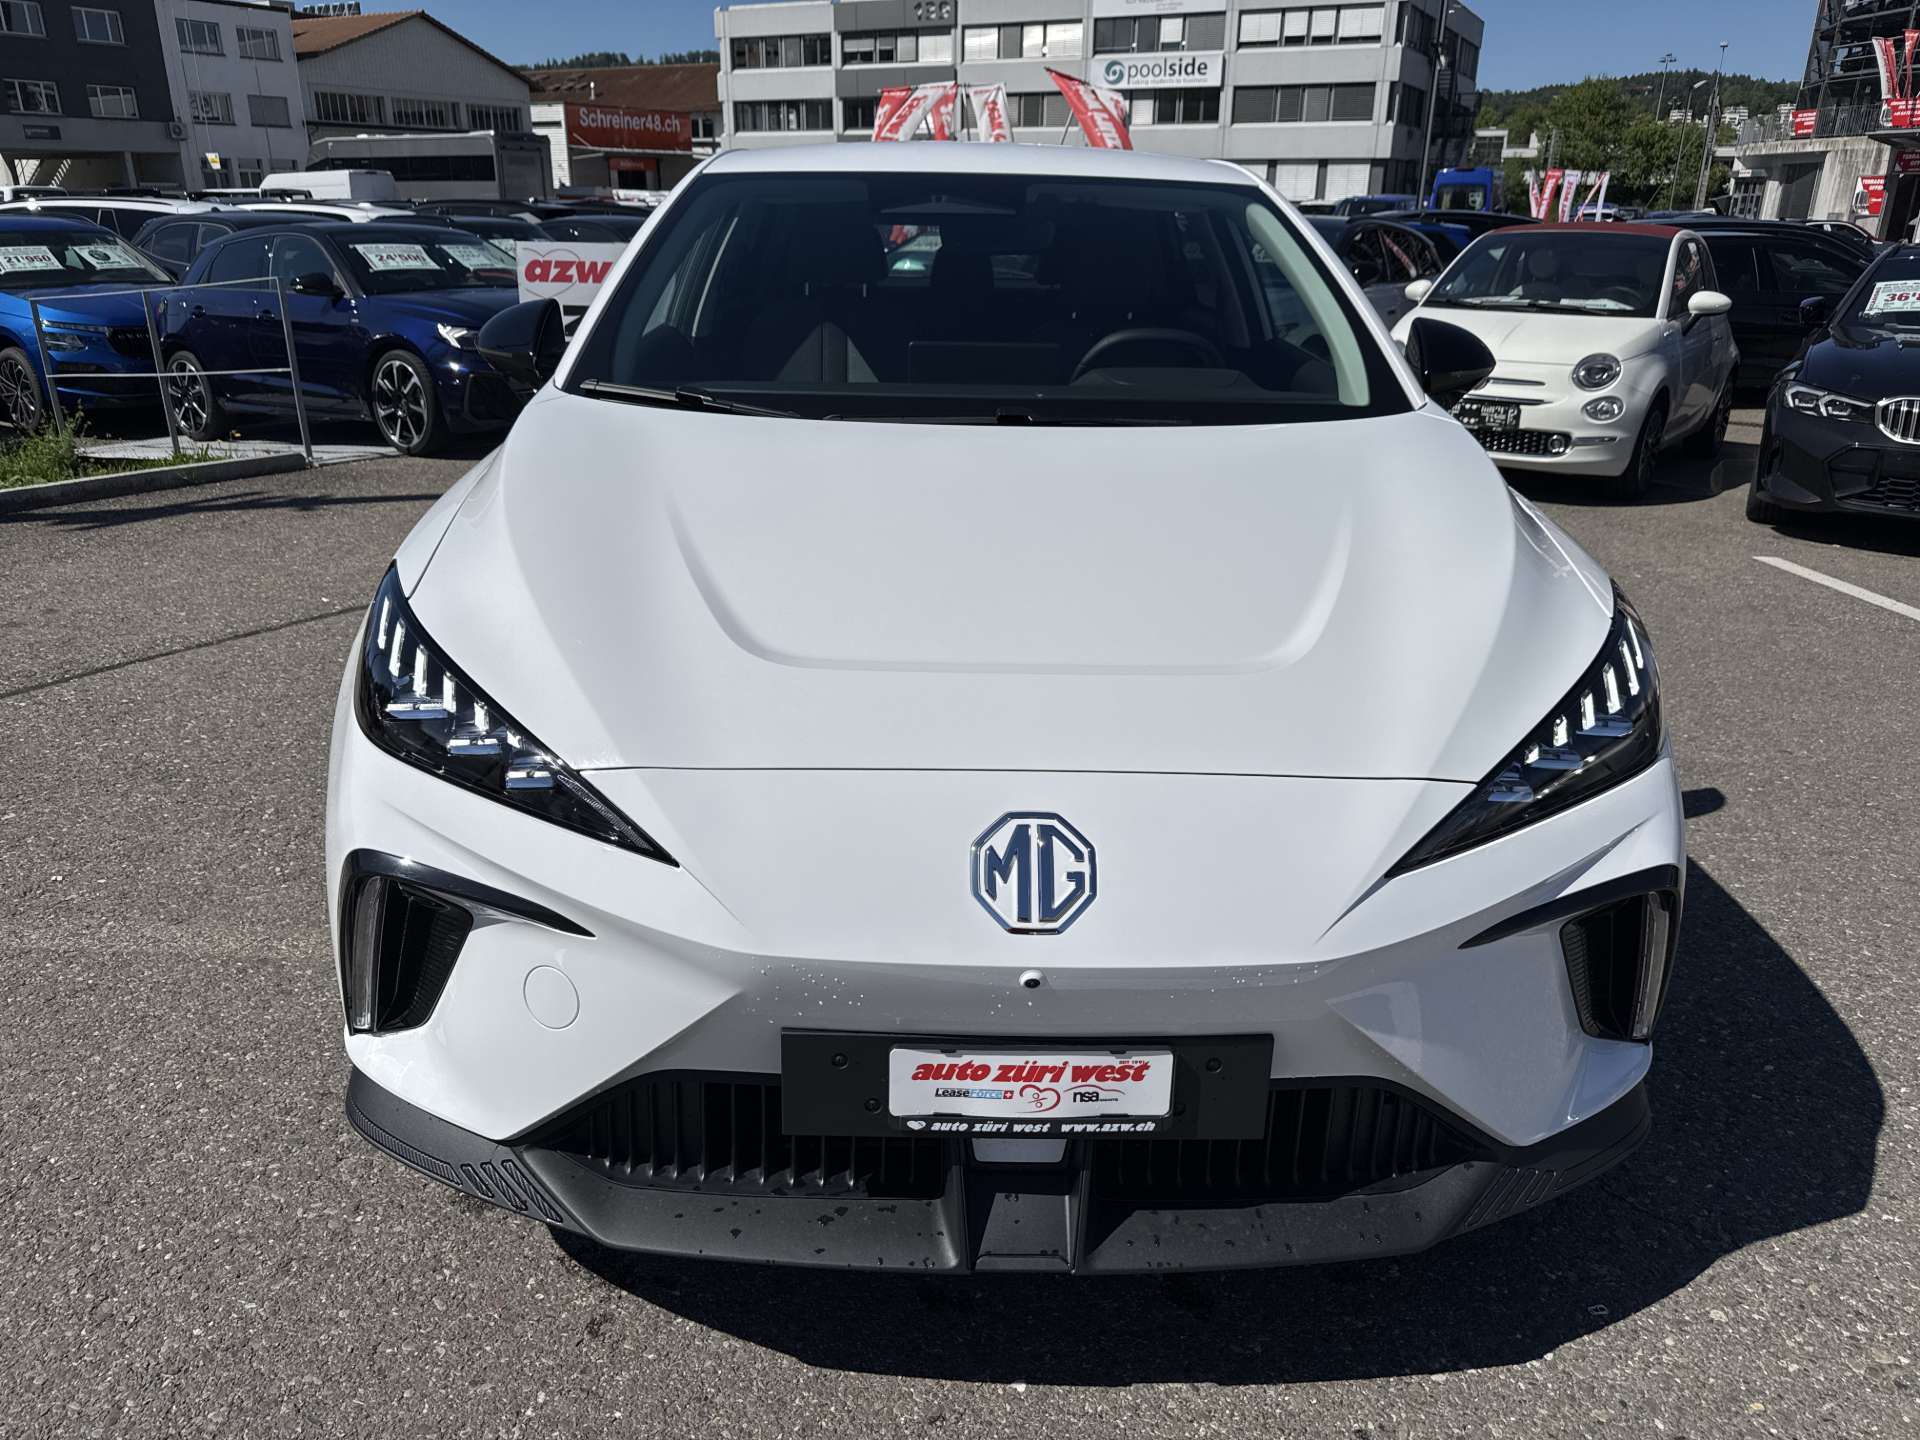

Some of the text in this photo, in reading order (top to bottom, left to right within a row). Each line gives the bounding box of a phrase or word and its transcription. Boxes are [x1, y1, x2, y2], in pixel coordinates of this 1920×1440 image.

[1127, 57, 1208, 84] poolside
[579, 107, 681, 134] Schreiner48.ch
[524, 259, 613, 284] azw
[984, 823, 1086, 923] MG
[911, 1060, 1151, 1083] auto züri west
[935, 1087, 1002, 1099] LeaseForce
[1073, 1091, 1100, 1103] nsa
[931, 1121, 1156, 1133] auto züri west www.azw.ch
